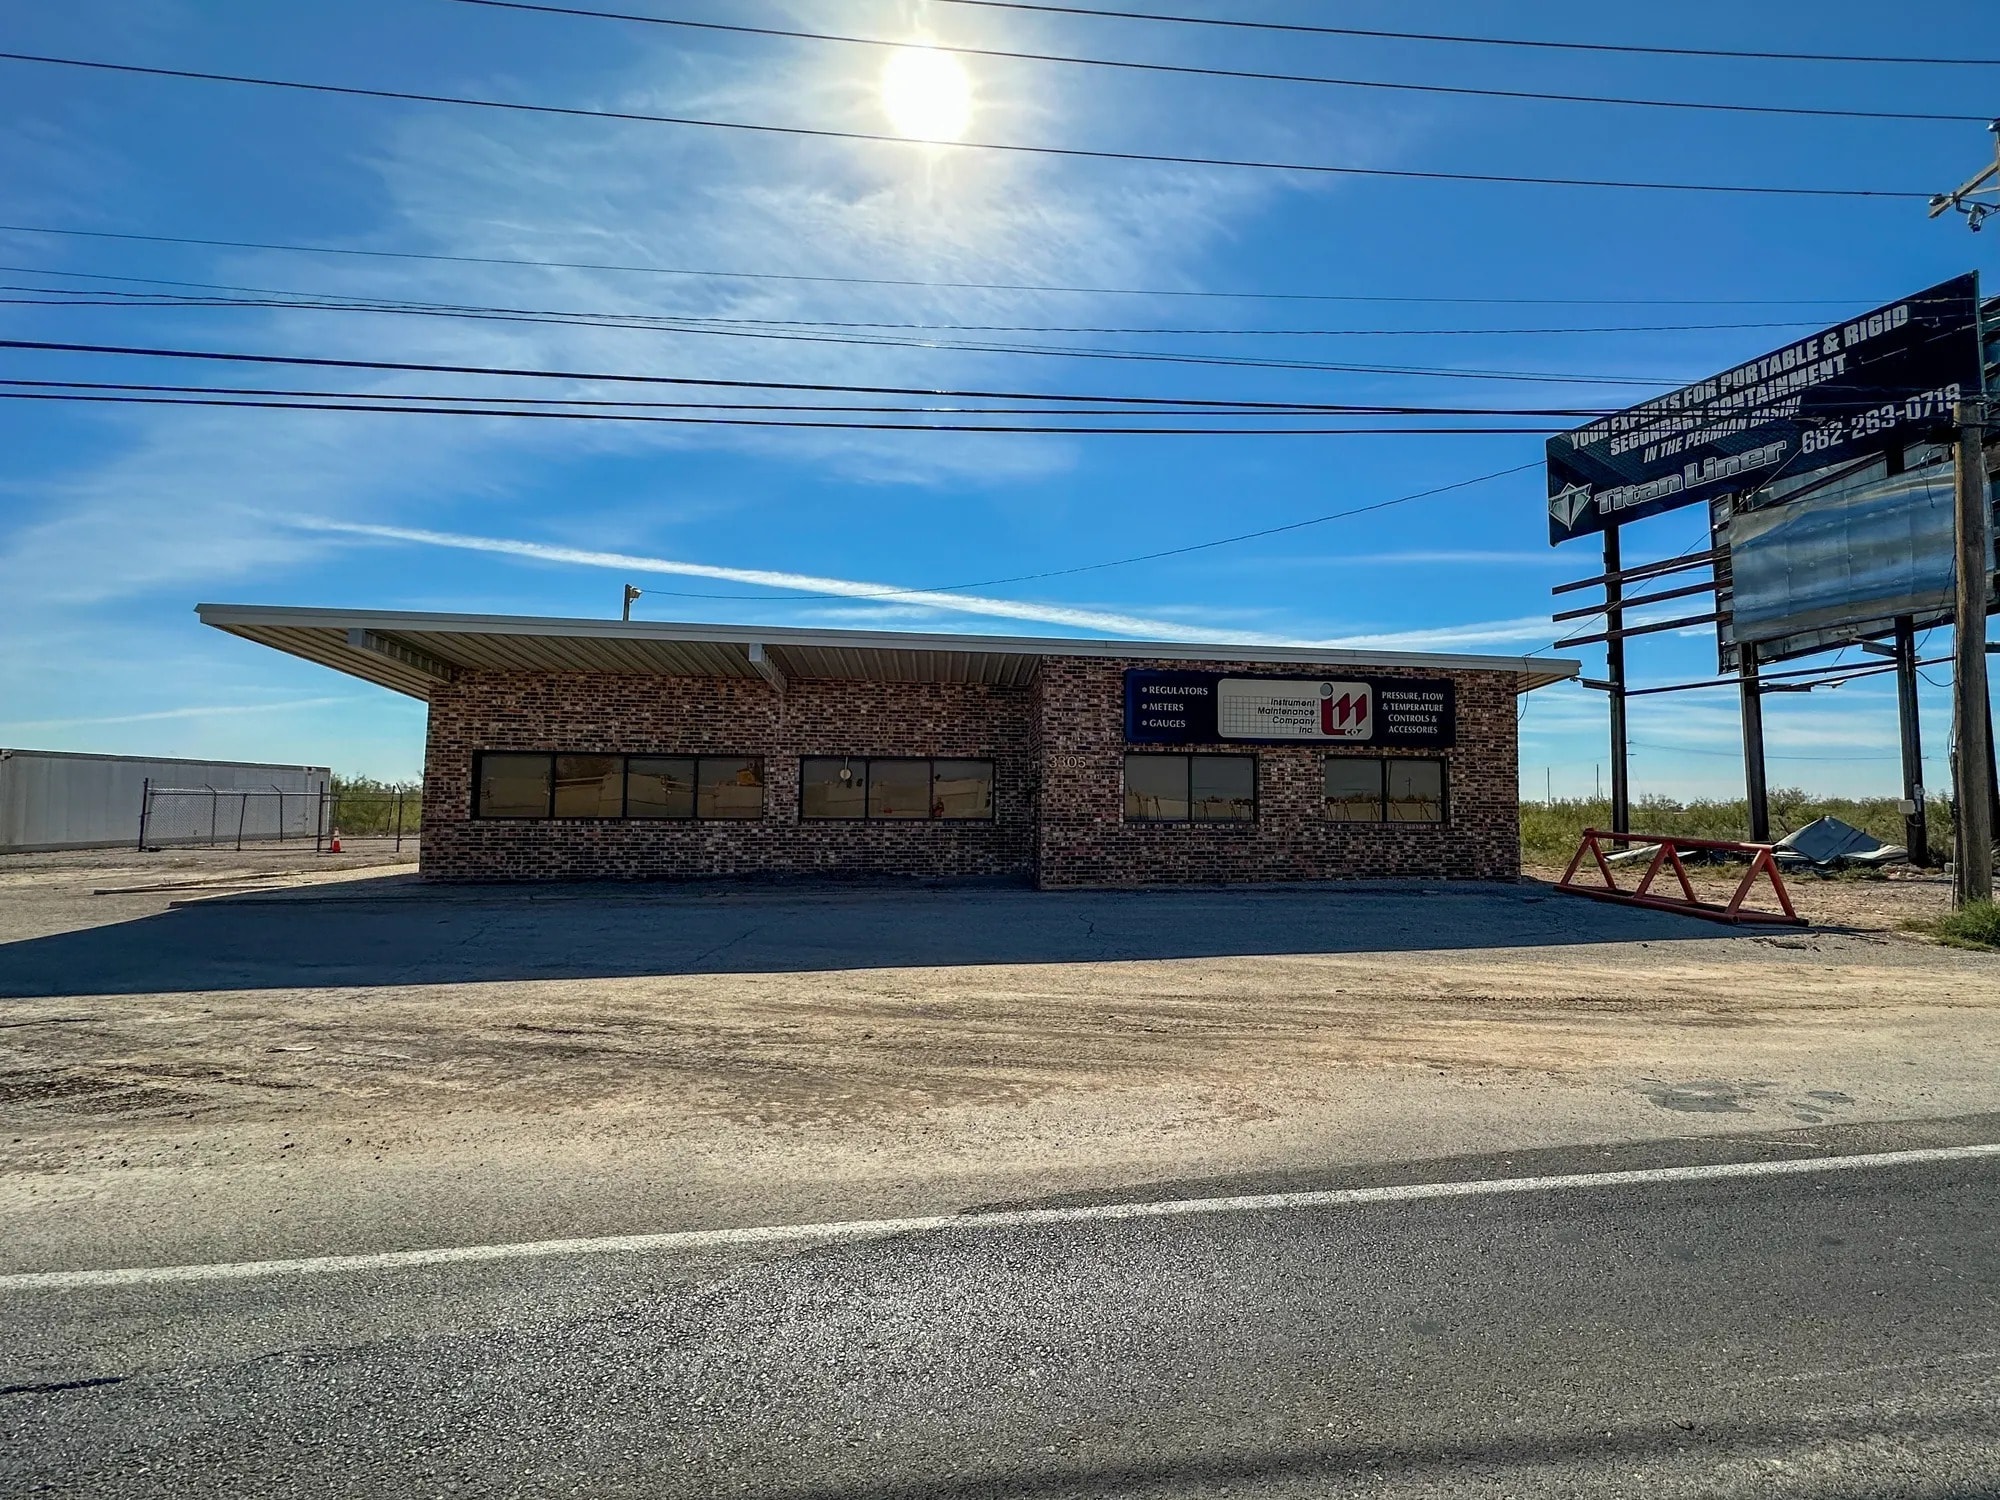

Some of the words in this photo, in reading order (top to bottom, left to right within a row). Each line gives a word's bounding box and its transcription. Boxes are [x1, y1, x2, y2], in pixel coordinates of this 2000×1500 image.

[1571, 421, 1609, 450] YOUR
[1611, 393, 1681, 433] EXPERTS
[1683, 379, 1717, 408] FOR
[1720, 339, 1819, 393] PORTABLE
[1823, 332, 1841, 355] &
[1844, 304, 1909, 348] RIGID
[1610, 408, 1704, 456] SECONDARY
[1707, 353, 1847, 421] CONTAINMENT
[1643, 445, 1658, 464] IN
[1660, 436, 1684, 458] THE
[1685, 414, 1747, 450] PERMIAN
[1594, 474, 1684, 515] Titan
[1684, 439, 1788, 490] Liner
[1149, 685, 1209, 696] REGULATORS
[1381, 691, 1421, 701] PRESSURE,
[1422, 692, 1444, 701] FLOW
[1149, 702, 1184, 712] METERS
[1270, 698, 1316, 707] Instrument
[1382, 702, 1389, 711] &
[1390, 702, 1444, 712] TEMPERATURE
[1257, 706, 1315, 716] Maintenance
[1149, 719, 1186, 728] GAUGES
[1272, 716, 1316, 727] Company
[1388, 714, 1430, 723] CONTROLS
[1431, 715, 1438, 723] &
[1388, 725, 1438, 734] ACCESSORIES
[1048, 756, 1087, 768] 3305
